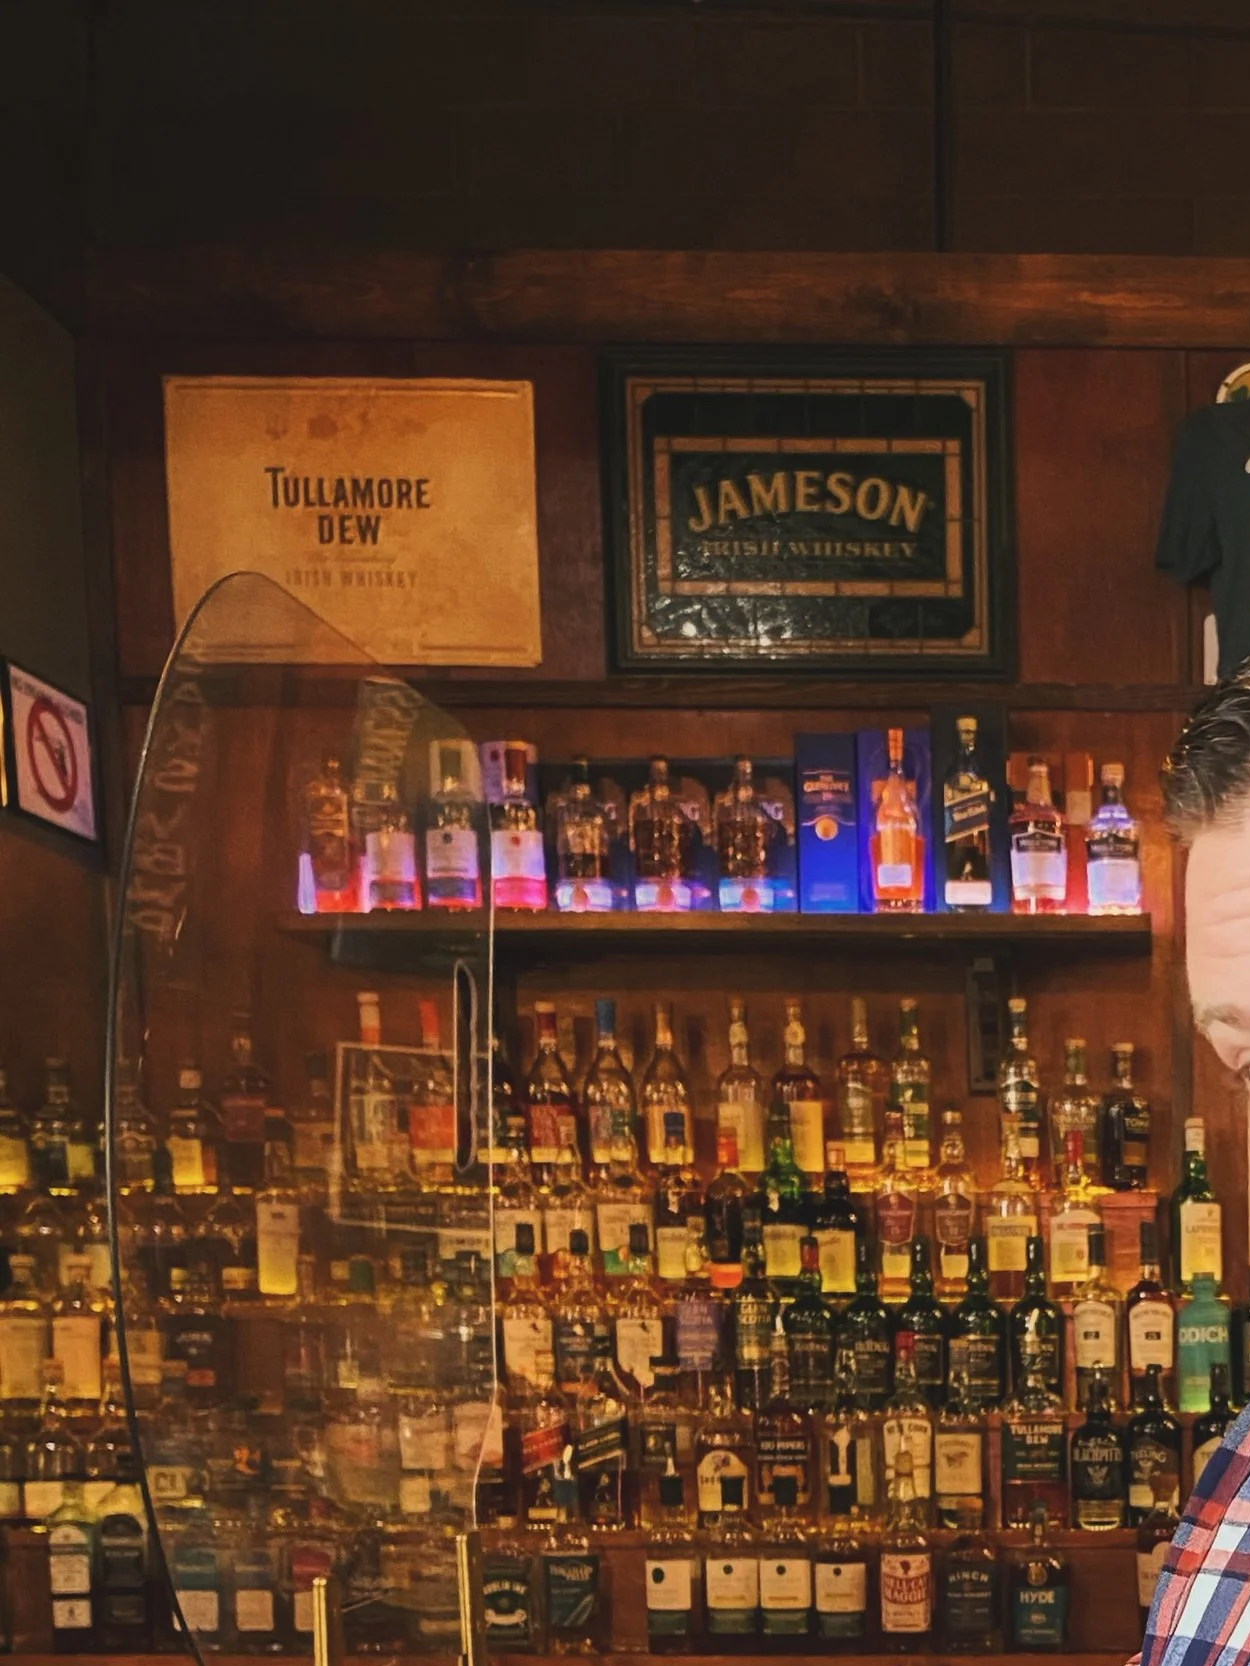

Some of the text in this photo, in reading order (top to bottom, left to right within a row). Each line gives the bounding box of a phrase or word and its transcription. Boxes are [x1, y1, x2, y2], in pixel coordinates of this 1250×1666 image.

[264, 467, 431, 509] TULLAMORE
[688, 471, 929, 532] JAMESON
[317, 514, 381, 544] DEW
[702, 540, 918, 558] IRISH WHISKEY
[1020, 1590, 1056, 1604] HYDE
